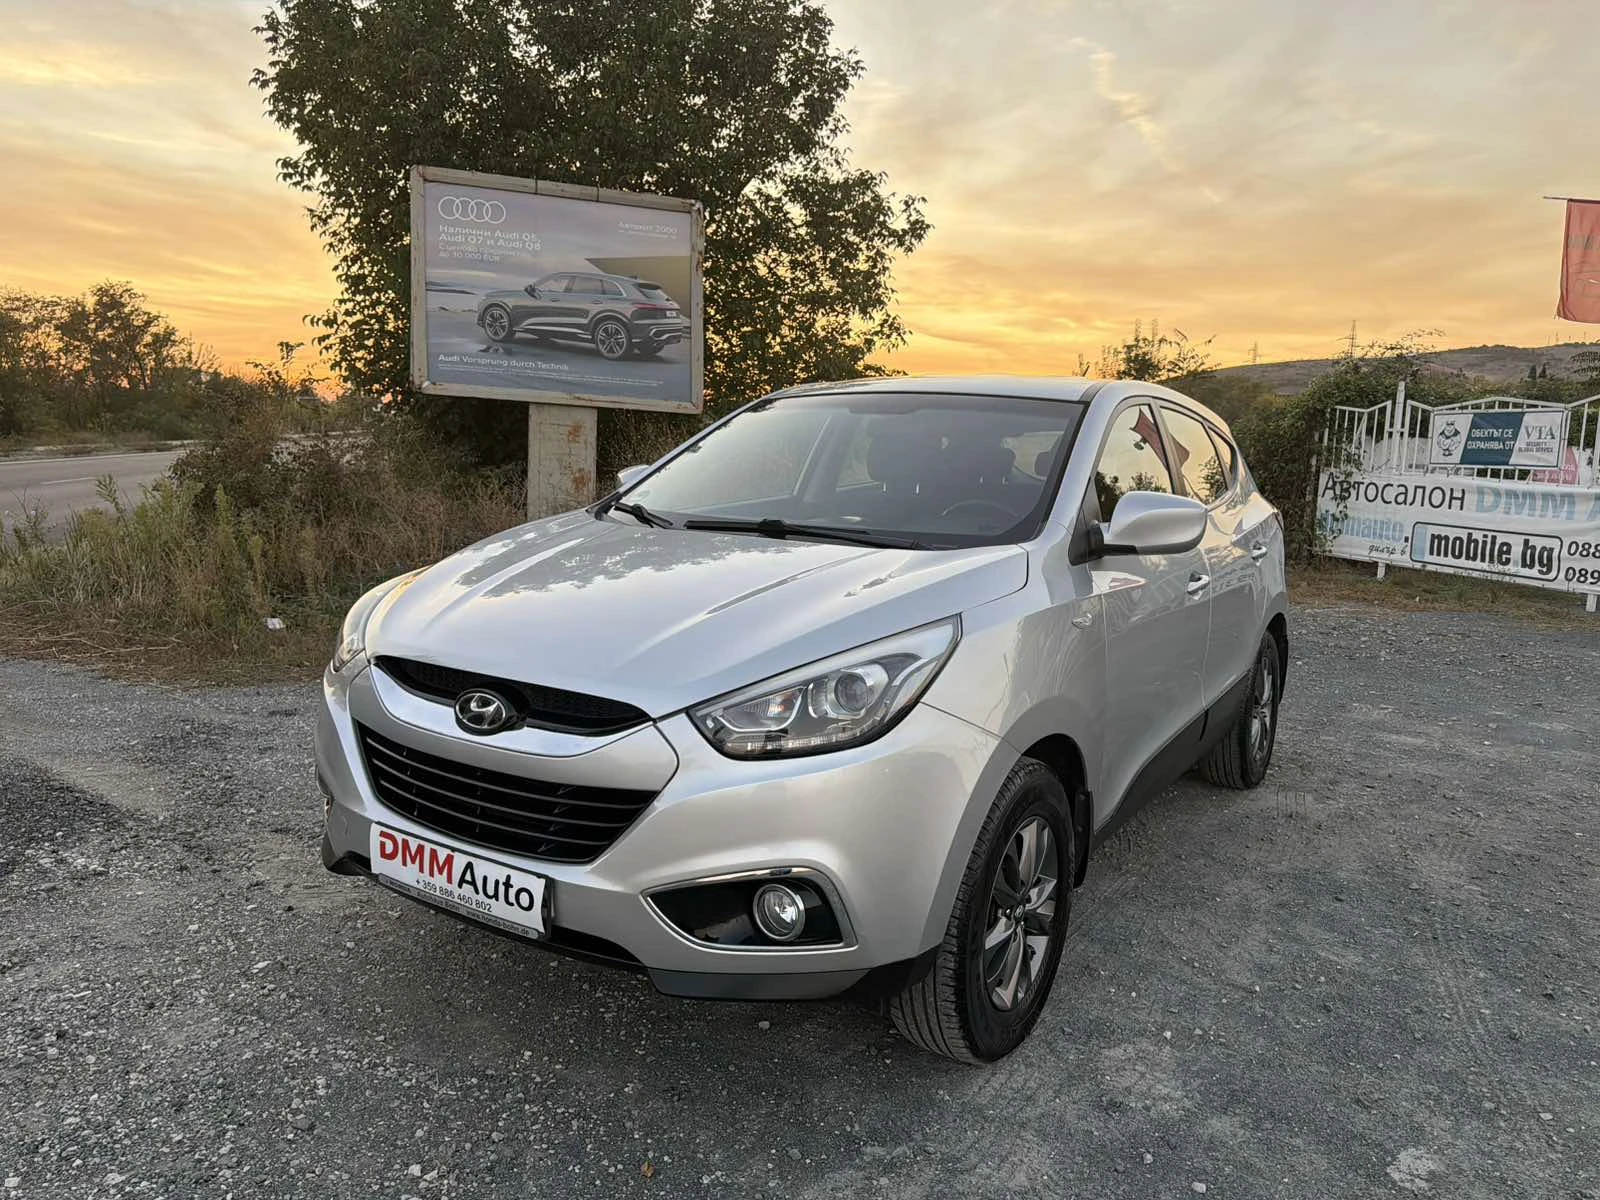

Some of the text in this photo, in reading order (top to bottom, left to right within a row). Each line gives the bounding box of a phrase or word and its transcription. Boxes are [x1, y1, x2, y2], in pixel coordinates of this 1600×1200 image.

[439, 233, 465, 243] Audi
[497, 239, 523, 249] Audi
[494, 230, 519, 241] Audi
[438, 353, 569, 371] Audi Vorsprung durch Technik
[1503, 428, 1514, 438] СЕ
[1524, 424, 1556, 440] VTA
[1466, 440, 1515, 450] ОХРАНЯВА ОТ
[1321, 471, 1466, 511] Автосалон
[1475, 485, 1576, 521] DMM
[1567, 540, 1600, 559] 088
[1564, 566, 1600, 585] 089
[379, 830, 535, 912] DMM Auto
[422, 879, 437, 894] 359
[457, 893, 473, 906] 460
[475, 900, 492, 913] 802
